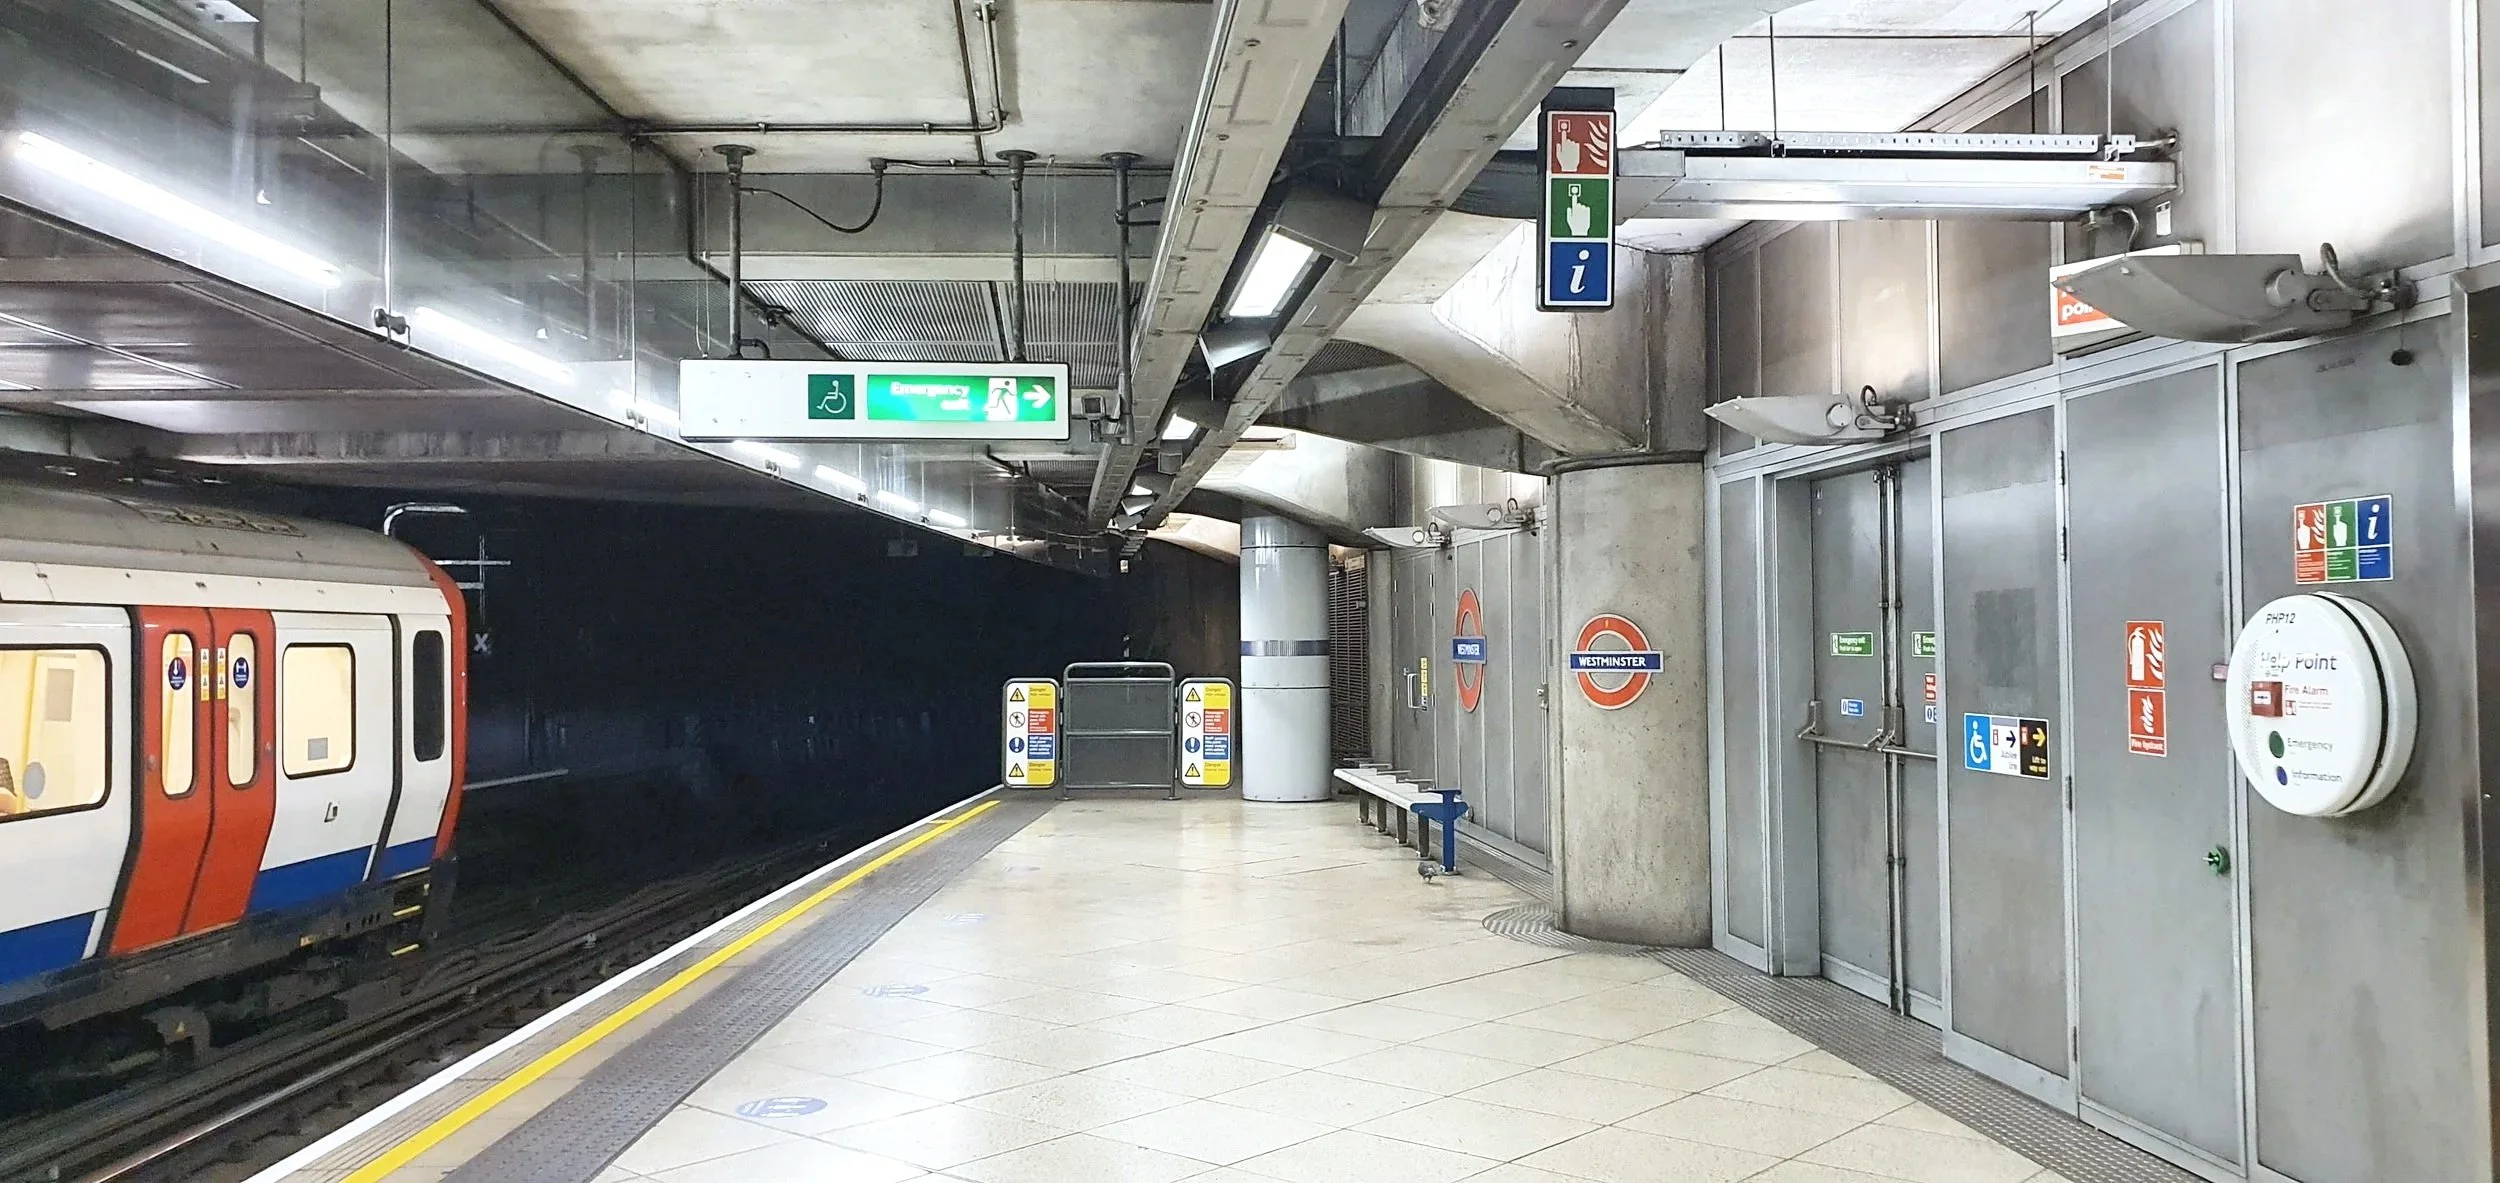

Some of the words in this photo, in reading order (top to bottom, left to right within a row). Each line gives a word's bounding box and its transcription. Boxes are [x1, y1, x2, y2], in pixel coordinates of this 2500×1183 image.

[2265, 612, 2296, 624] PHP12
[1578, 655, 1647, 667] WESTMINSTER
[2261, 651, 2291, 672] Help
[2295, 652, 2338, 671] Point
[2285, 684, 2299, 694] Fire
[2302, 685, 2329, 696] Alarm
[2287, 738, 2333, 752] Emergency
[2292, 769, 2343, 783] Information
